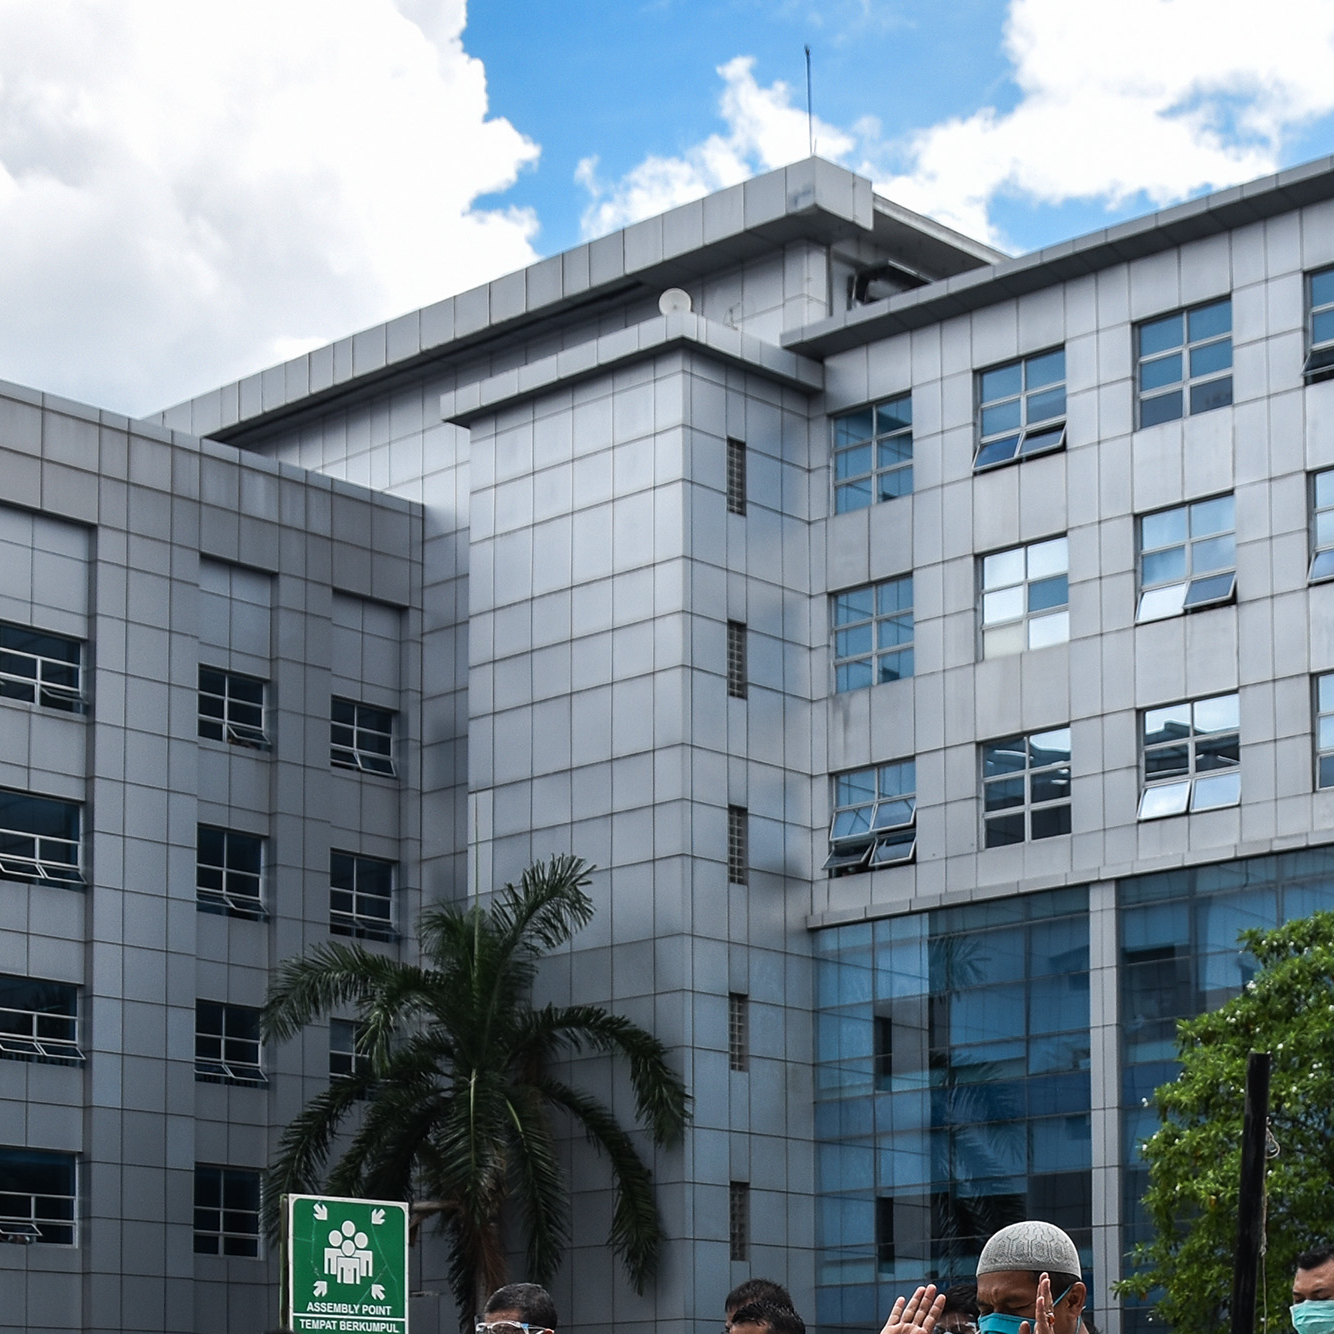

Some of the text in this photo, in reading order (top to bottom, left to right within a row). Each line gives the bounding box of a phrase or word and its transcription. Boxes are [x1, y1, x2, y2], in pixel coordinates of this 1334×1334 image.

[306, 1301, 392, 1316] ASSEMBLY POINT
[299, 1318, 400, 1334] TEMPAT BERKUMPUL
